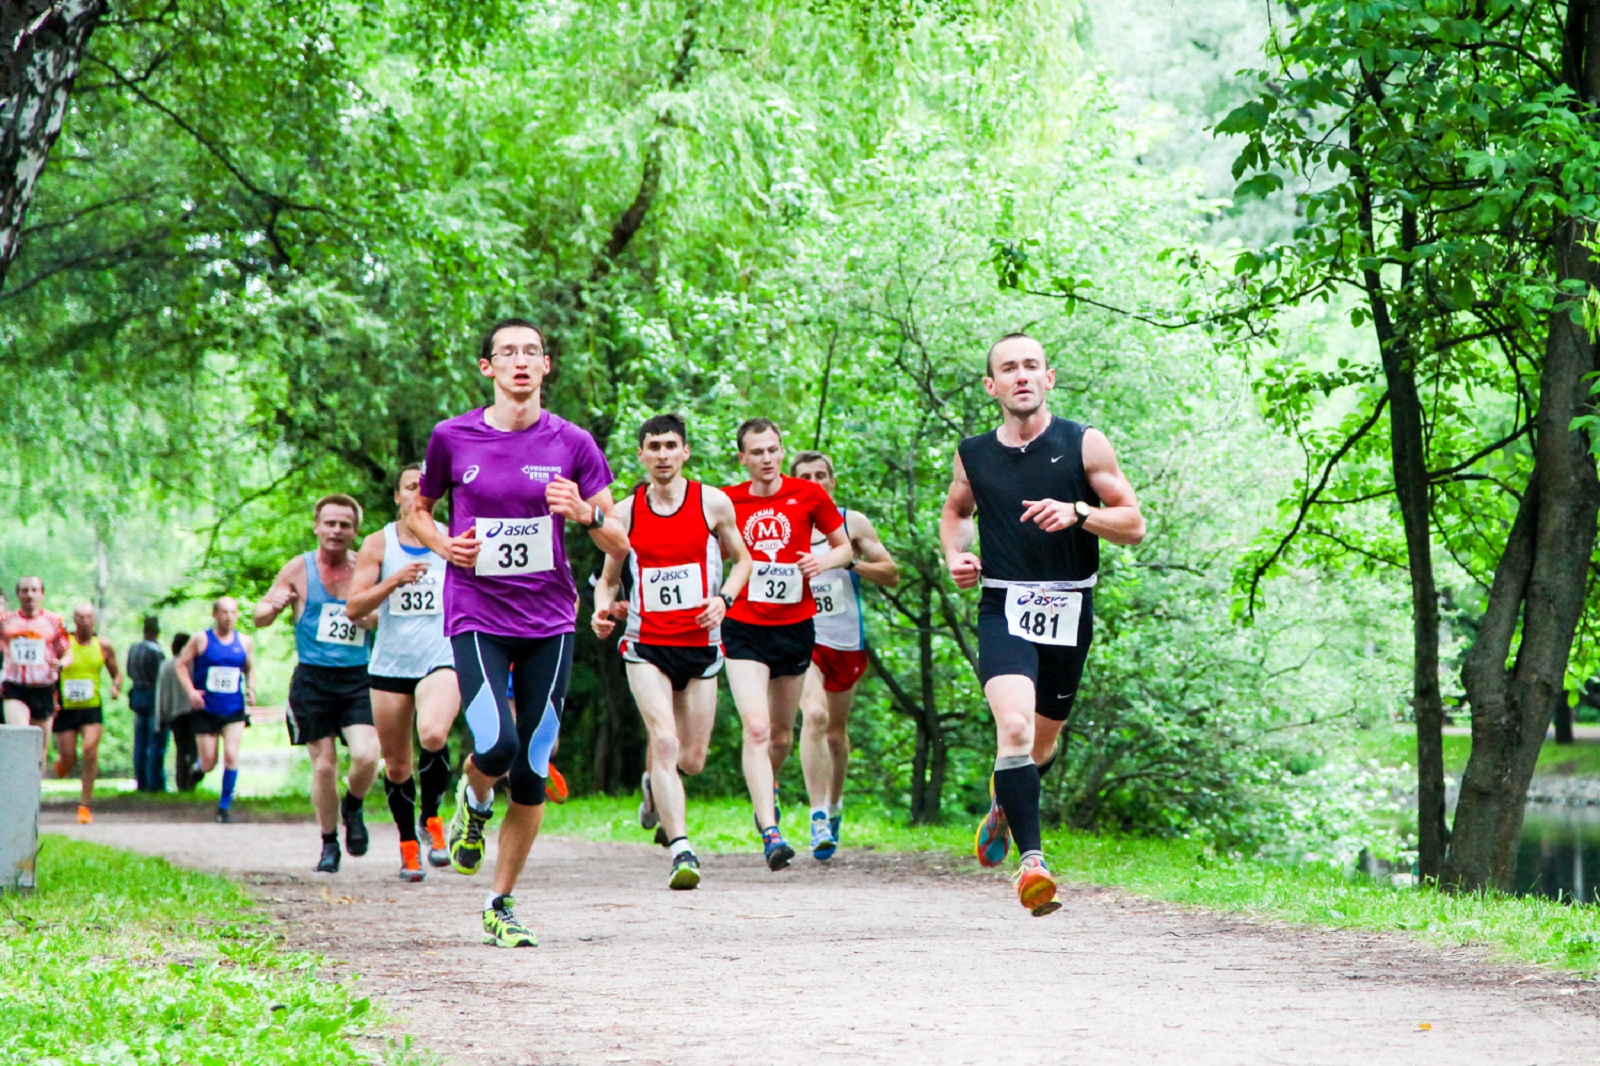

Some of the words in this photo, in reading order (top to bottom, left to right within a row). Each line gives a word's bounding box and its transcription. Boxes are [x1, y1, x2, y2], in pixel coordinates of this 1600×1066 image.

[498, 543, 529, 568] 33
[660, 585, 682, 605] 61
[765, 579, 787, 599] 32
[401, 591, 435, 611] 332
[329, 621, 357, 641] 239
[1019, 611, 1059, 639] 481
